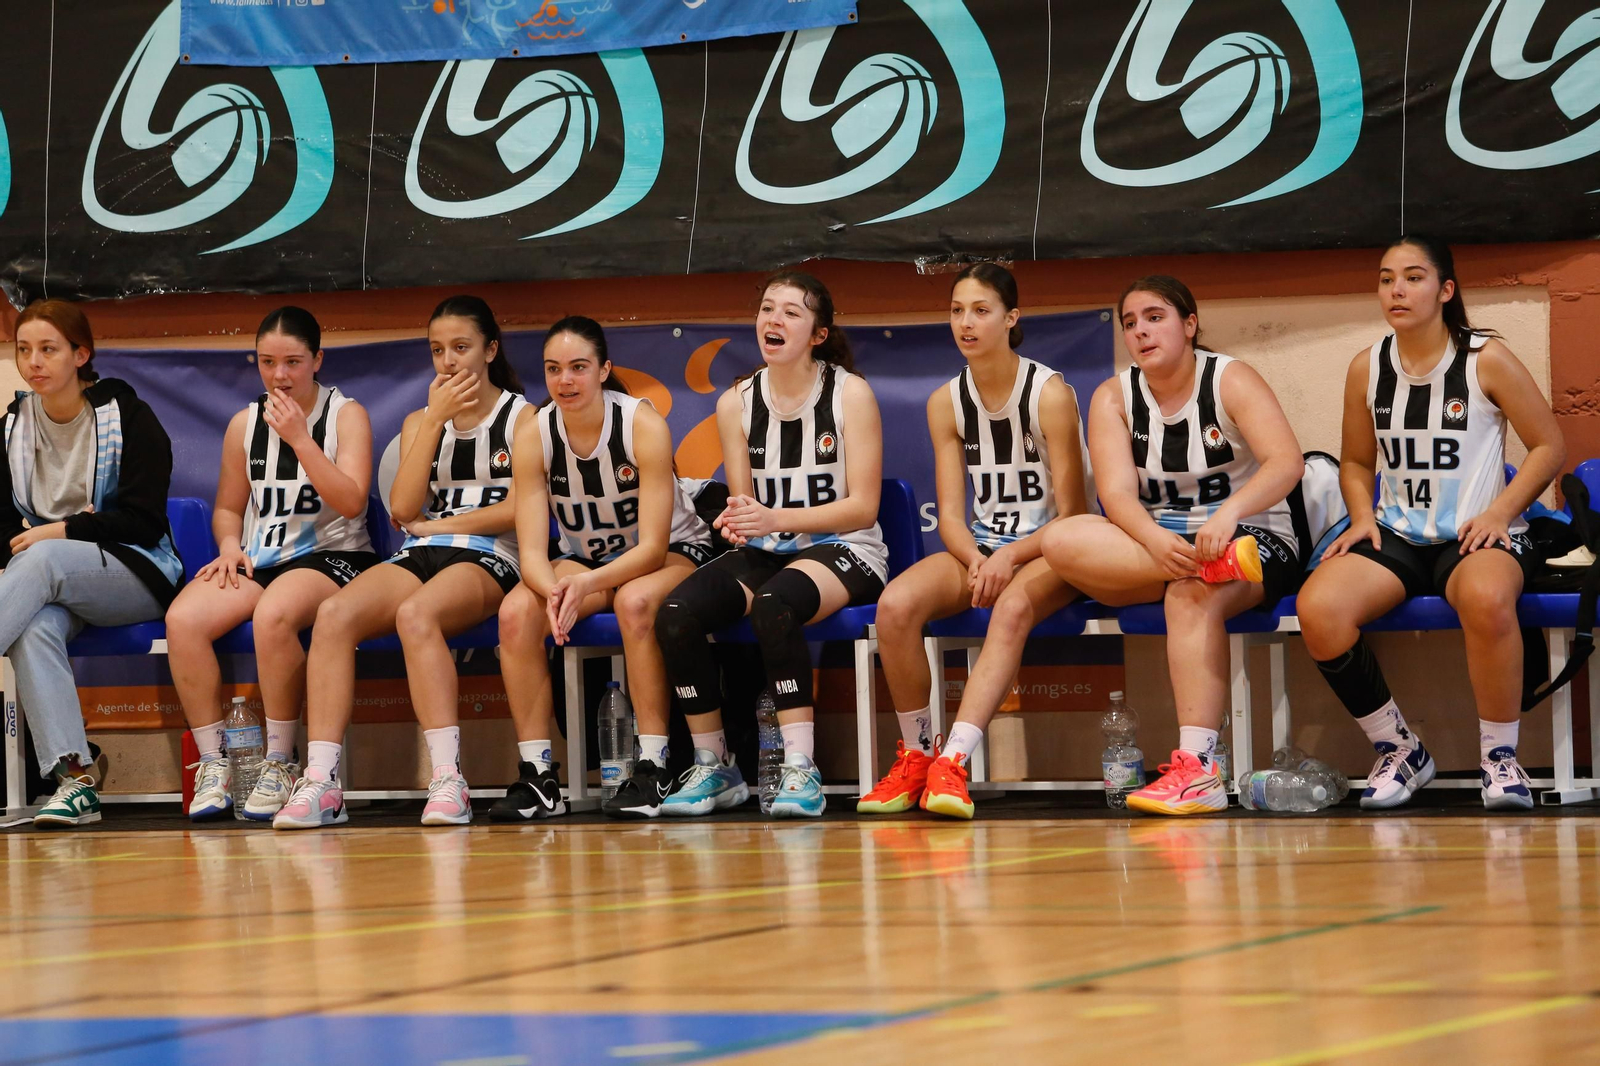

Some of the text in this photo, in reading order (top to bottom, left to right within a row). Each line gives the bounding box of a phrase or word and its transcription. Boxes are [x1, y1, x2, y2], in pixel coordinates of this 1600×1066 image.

[1375, 406, 1391, 415] vive
[1133, 431, 1149, 442] ive
[1379, 437, 1460, 470] ULB
[552, 473, 567, 483] vive
[970, 470, 1044, 505] ULB
[752, 473, 837, 509] ULB
[1403, 478, 1432, 508] 14
[556, 497, 639, 532] ULB
[990, 511, 1020, 535] 51
[264, 522, 287, 547] 11
[587, 533, 627, 561] 22
[834, 556, 852, 573] 3
[680, 685, 698, 699] NBA
[781, 679, 799, 694] NBA
[1011, 682, 1092, 699] w.mgs.es
[96, 703, 135, 715] Agente
[137, 702, 151, 712] de
[153, 702, 184, 714] Segur
